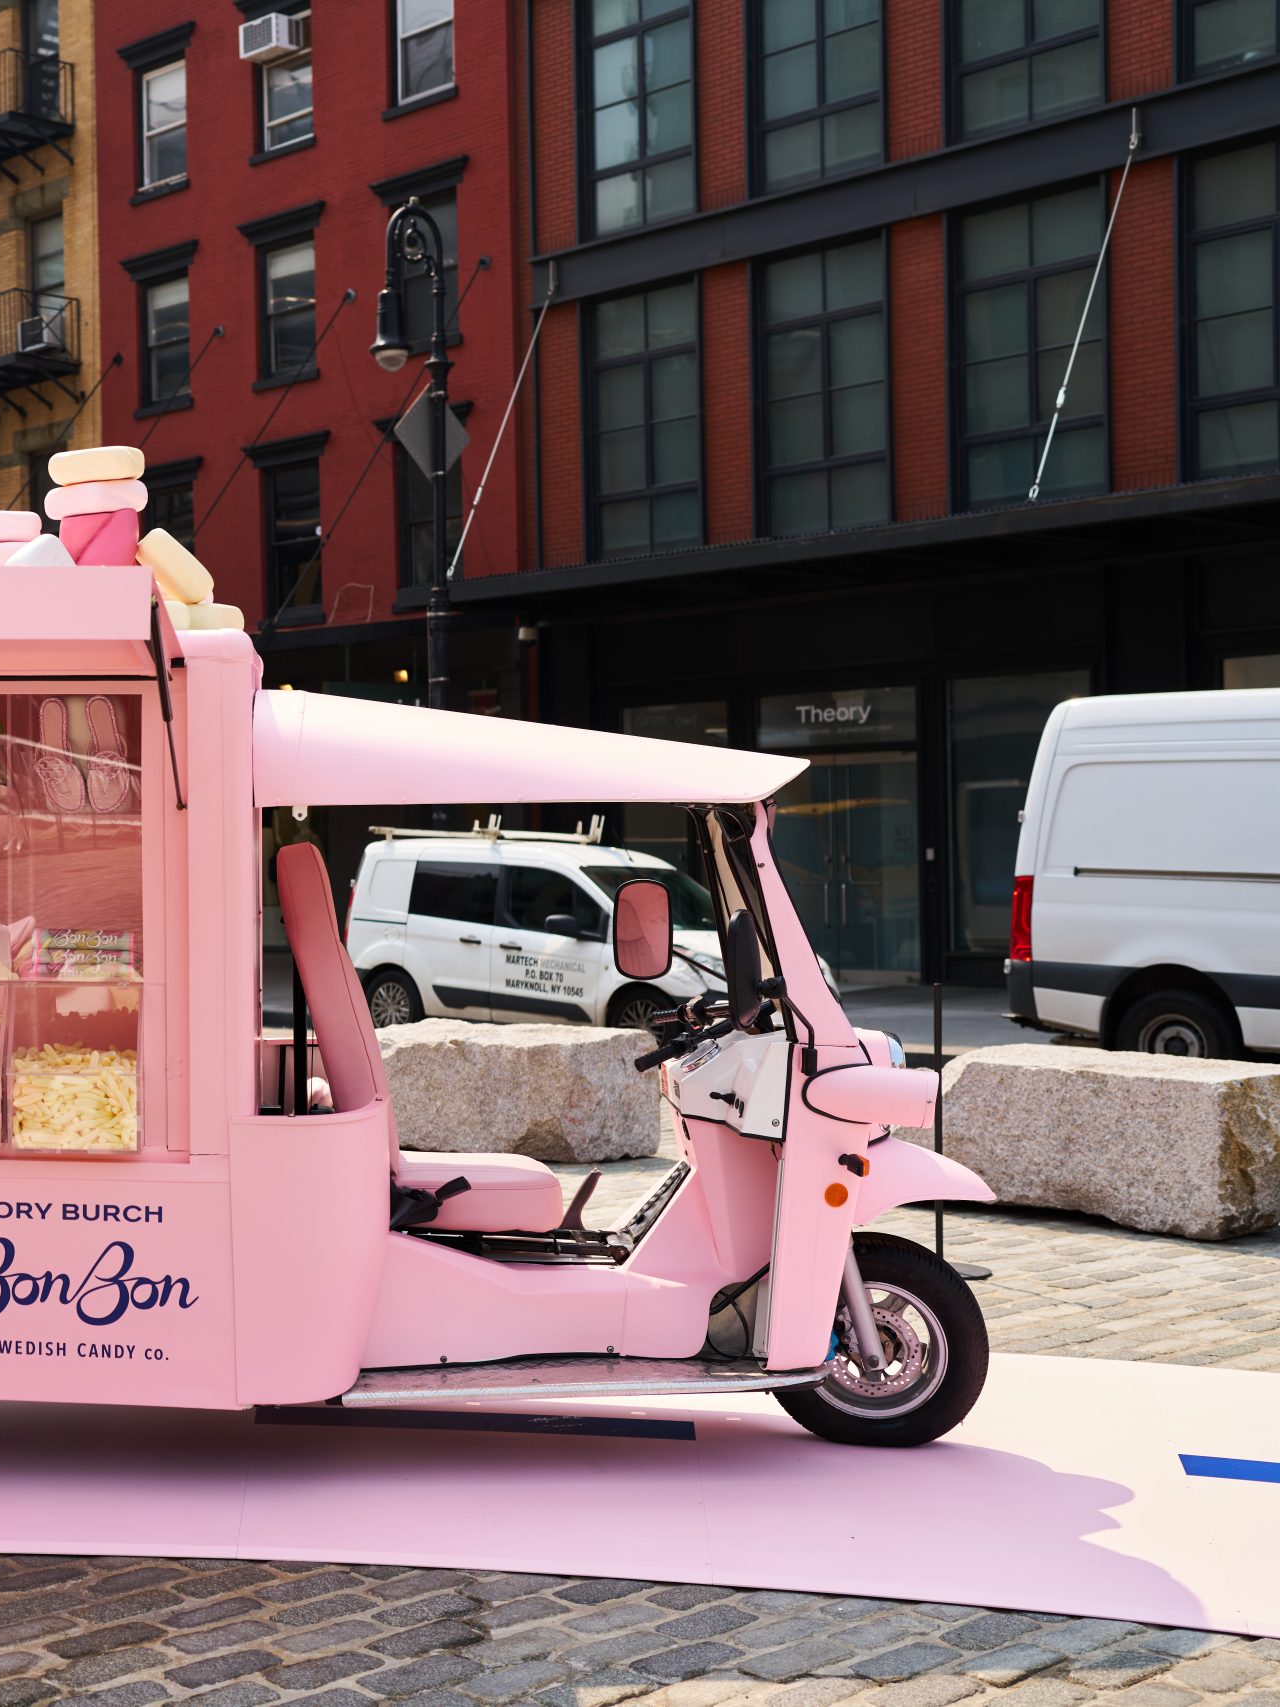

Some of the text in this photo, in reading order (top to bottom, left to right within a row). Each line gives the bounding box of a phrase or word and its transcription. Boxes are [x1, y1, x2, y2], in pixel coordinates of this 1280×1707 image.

[795, 705, 872, 724] Theory
[505, 954, 586, 973] MARTECH MECHANICAL
[525, 969, 564, 982] P.O. BOX 70
[505, 978, 584, 998] MARYKNOLL, NY 10545
[62, 1203, 163, 1223] BURCH
[77, 1343, 136, 1360] CANDY
